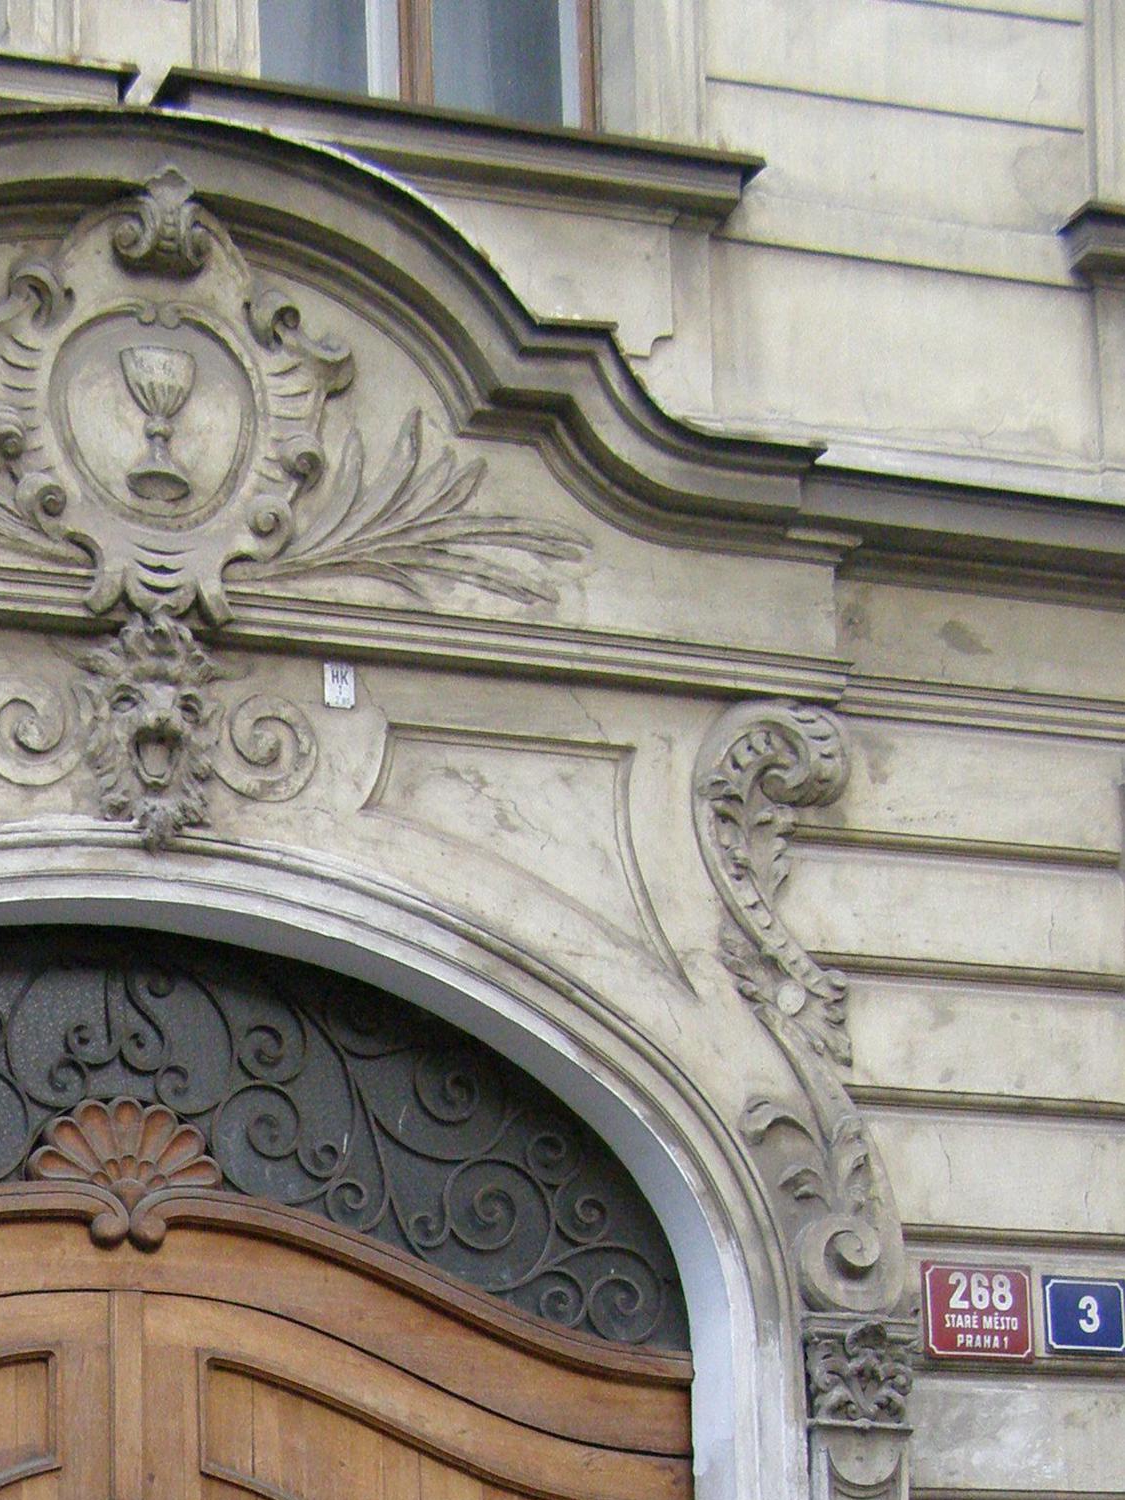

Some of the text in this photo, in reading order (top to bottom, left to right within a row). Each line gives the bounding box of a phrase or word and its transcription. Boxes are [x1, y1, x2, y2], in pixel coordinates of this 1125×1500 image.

[331, 668, 349, 686] HK
[948, 1271, 1013, 1311] 268
[944, 1312, 979, 1329] STARÉ
[1078, 1295, 1101, 1334] 3
[956, 1333, 1009, 1350] PRAHA 1
